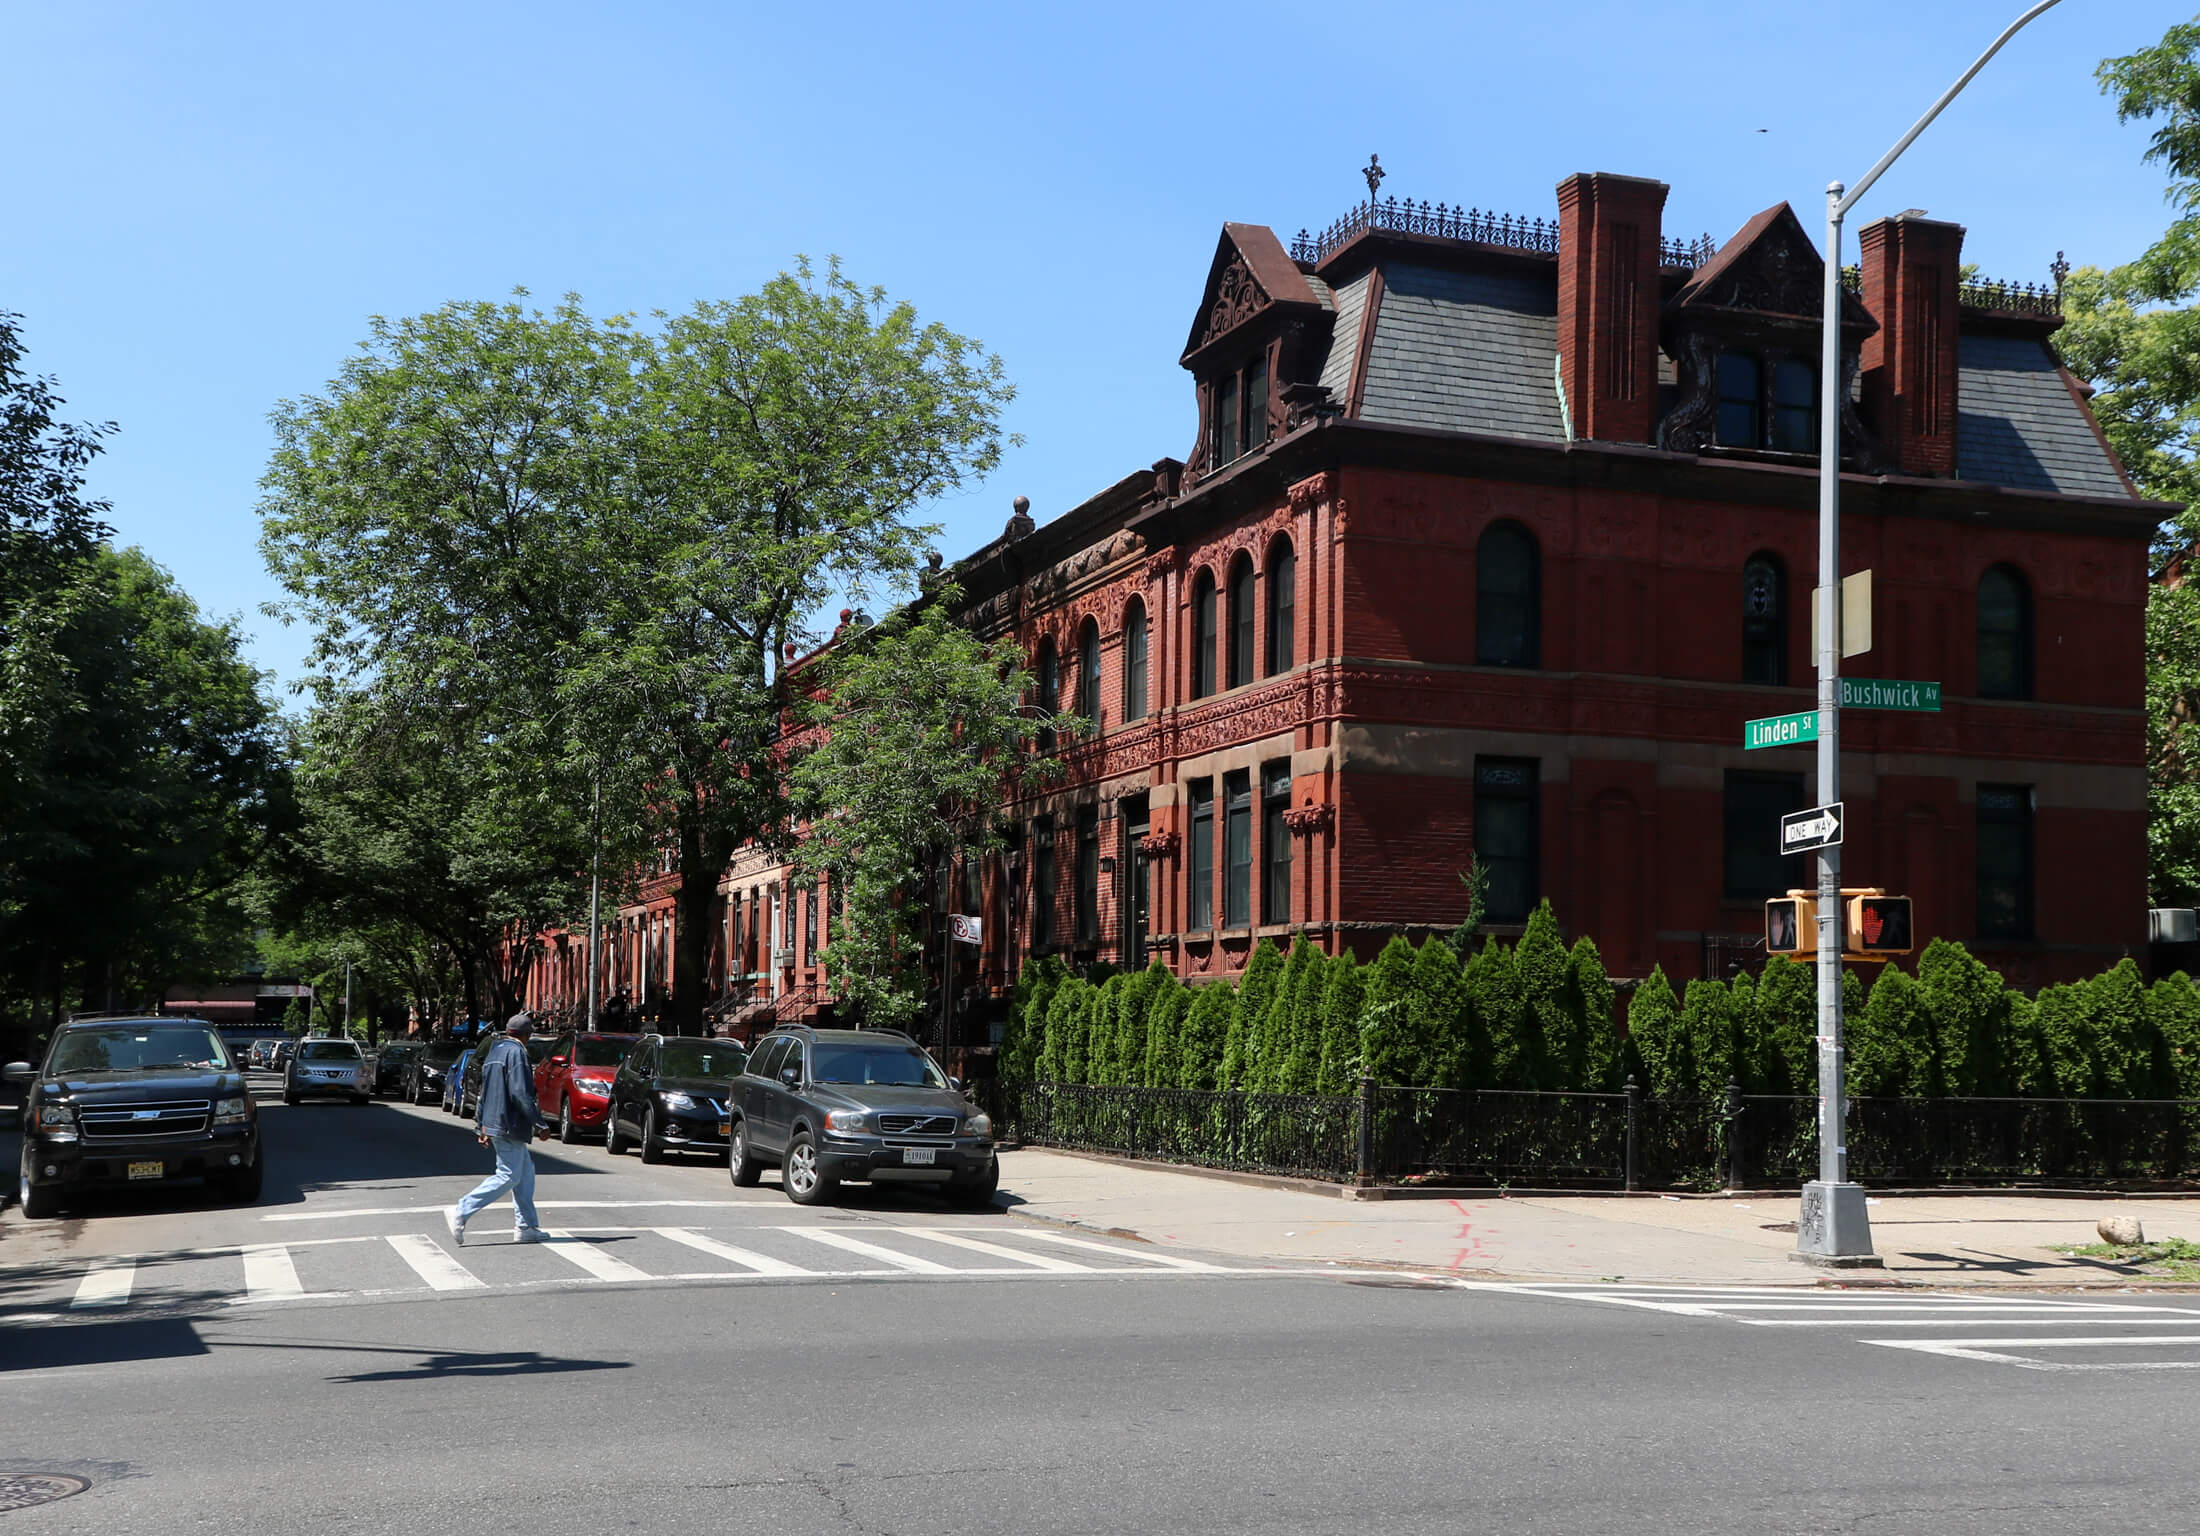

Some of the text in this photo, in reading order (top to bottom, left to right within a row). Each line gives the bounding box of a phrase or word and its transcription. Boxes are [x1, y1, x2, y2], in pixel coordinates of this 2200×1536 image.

[1843, 682, 1937, 707] Bushwick Av
[1752, 715, 1812, 745] Linden St
[1790, 818, 1833, 841] ONE WAY
